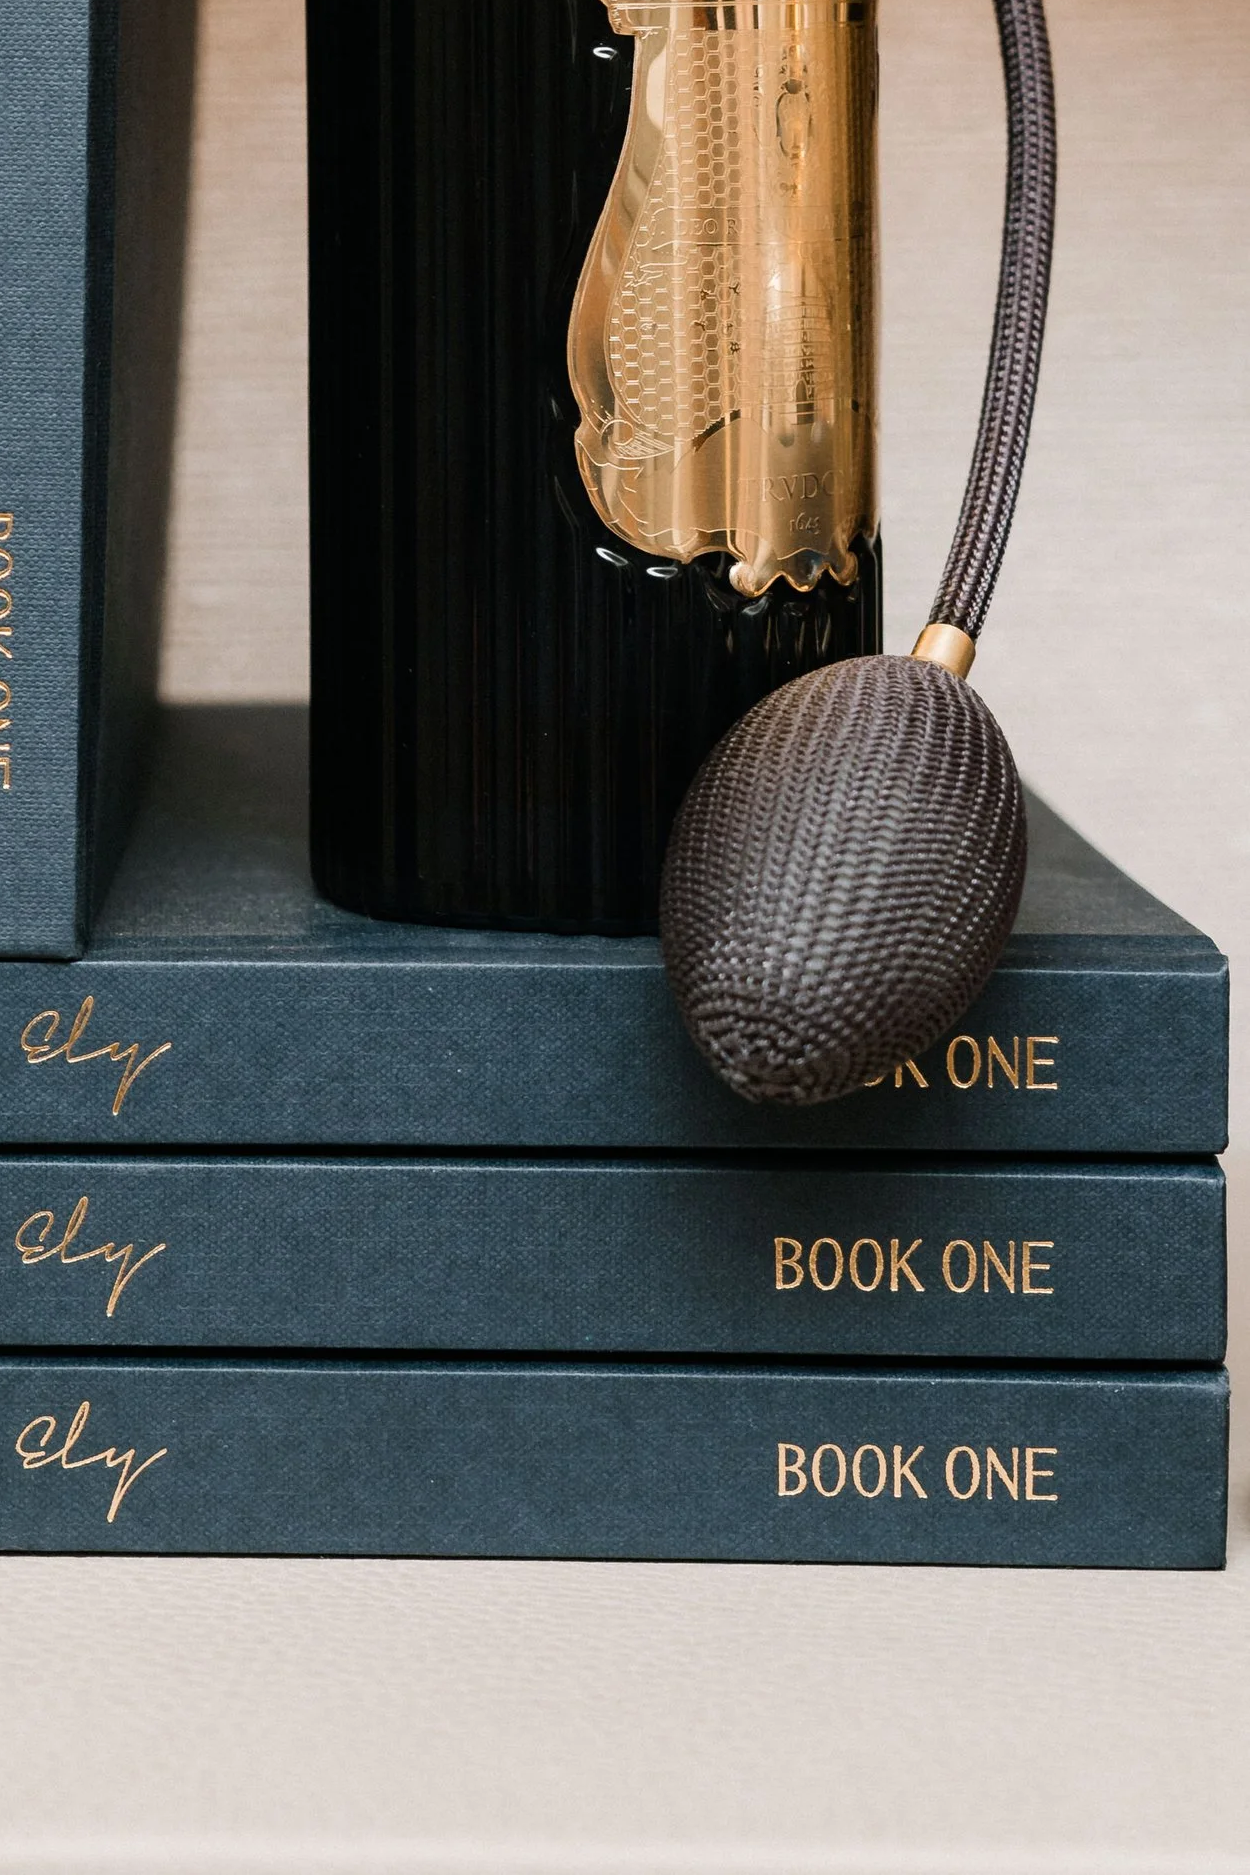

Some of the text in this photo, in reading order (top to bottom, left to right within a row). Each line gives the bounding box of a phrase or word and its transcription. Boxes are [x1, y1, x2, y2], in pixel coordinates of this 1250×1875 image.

[21, 997, 170, 1114] Ely
[947, 1036, 1058, 1089] ONE
[16, 1197, 166, 1315] Ely
[774, 1237, 1054, 1293] BOOK ONE
[16, 1401, 166, 1521] Ely
[778, 1443, 1057, 1500] BOOK ONE
